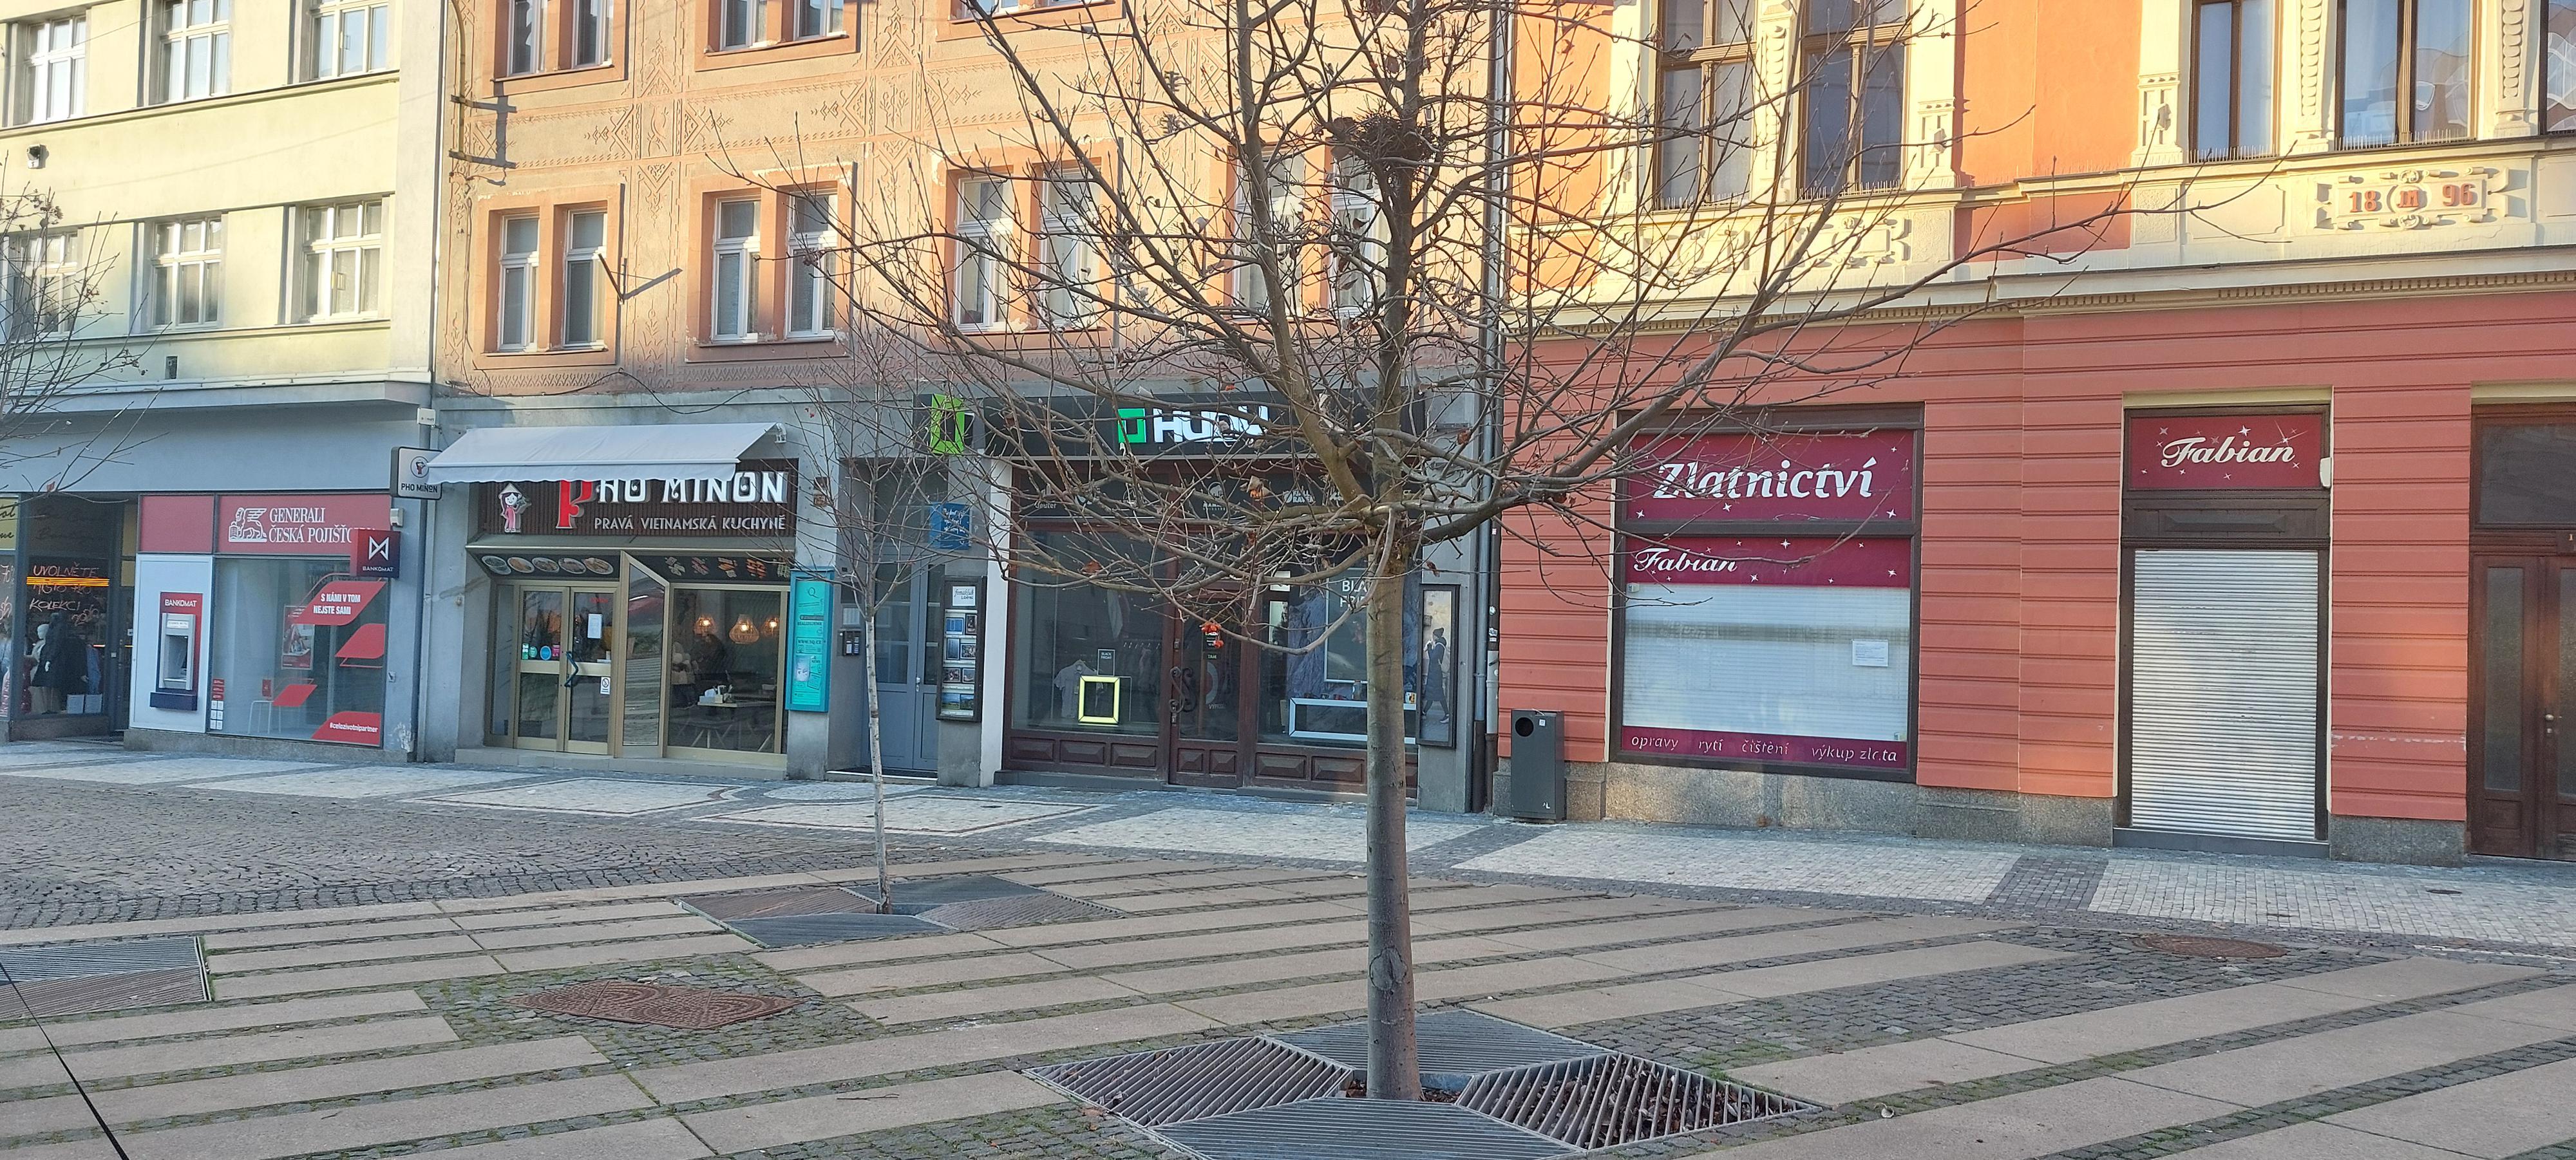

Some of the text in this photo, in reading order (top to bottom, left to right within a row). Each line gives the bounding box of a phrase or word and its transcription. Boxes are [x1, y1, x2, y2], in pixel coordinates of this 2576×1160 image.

[2349, 190, 2377, 212] 18
[2442, 183, 2476, 207] 96
[2161, 435, 2295, 467] Fabian
[1653, 456, 1877, 499] Zlatnictví
[401, 483, 415, 491] PHO
[269, 507, 326, 523] GENERALI
[594, 514, 786, 530] PRAVÁ VIETNAMSKÁ KUCHYNĚ
[268, 524, 304, 543] ČESKÁ
[1633, 547, 1738, 572] Fabian
[1341, 580, 1368, 593] BLA
[164, 599, 198, 607] BANKOMAT
[320, 592, 361, 603] S NÁMI V TOM
[313, 605, 335, 615] NEJSTE
[336, 605, 351, 615] SAMI
[1631, 735, 1679, 751] opravy
[1698, 738, 1724, 753] rytí
[1741, 738, 1790, 756] čištění
[1811, 744, 1855, 762] výkup
